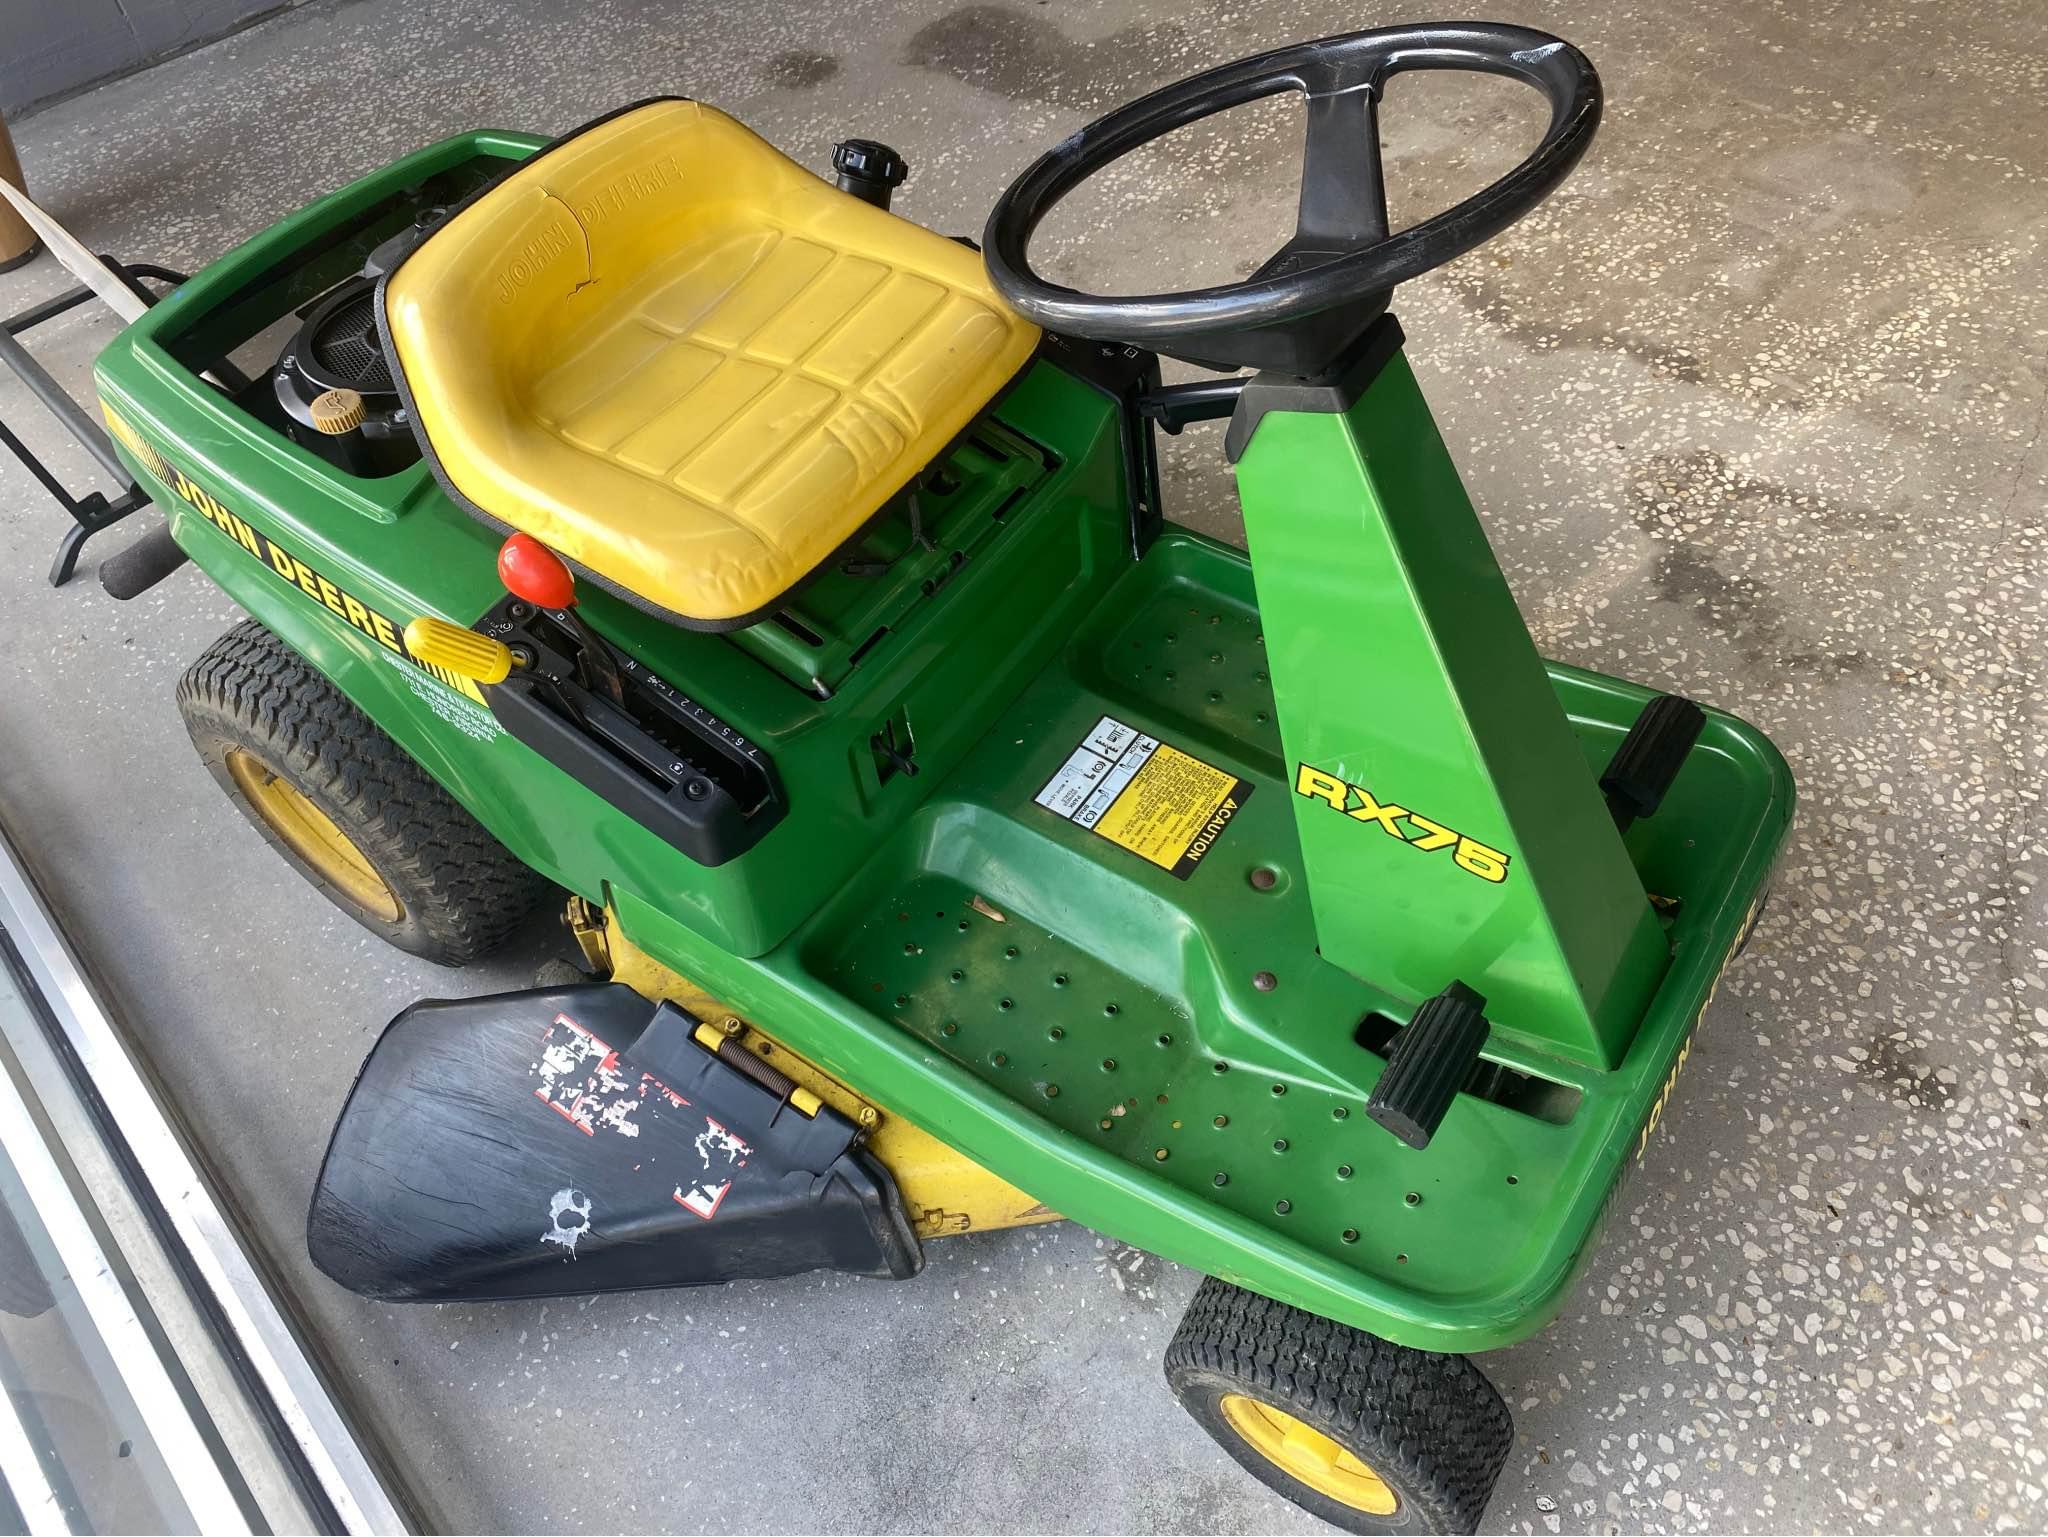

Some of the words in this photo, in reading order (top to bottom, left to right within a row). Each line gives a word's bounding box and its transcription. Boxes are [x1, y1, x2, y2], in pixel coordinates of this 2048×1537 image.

[497, 221, 574, 305] JOHN
[174, 470, 262, 558] JOHN
[267, 540, 402, 653] DEERE
[627, 660, 638, 670] N
[680, 698, 690, 706] 2
[694, 708, 704, 716] 3
[708, 718, 716, 726] 4
[722, 728, 730, 736] 5
[735, 737, 744, 746] 6
[748, 748, 758, 757] 7
[1127, 735, 1146, 754] CLUTCH
[1067, 794, 1081, 809] PARK
[1073, 803, 1090, 821] BRAKE
[1185, 806, 1232, 861] CAUTION
[1296, 761, 1511, 883] RX75
[1637, 1036, 1690, 1160] JOHN
